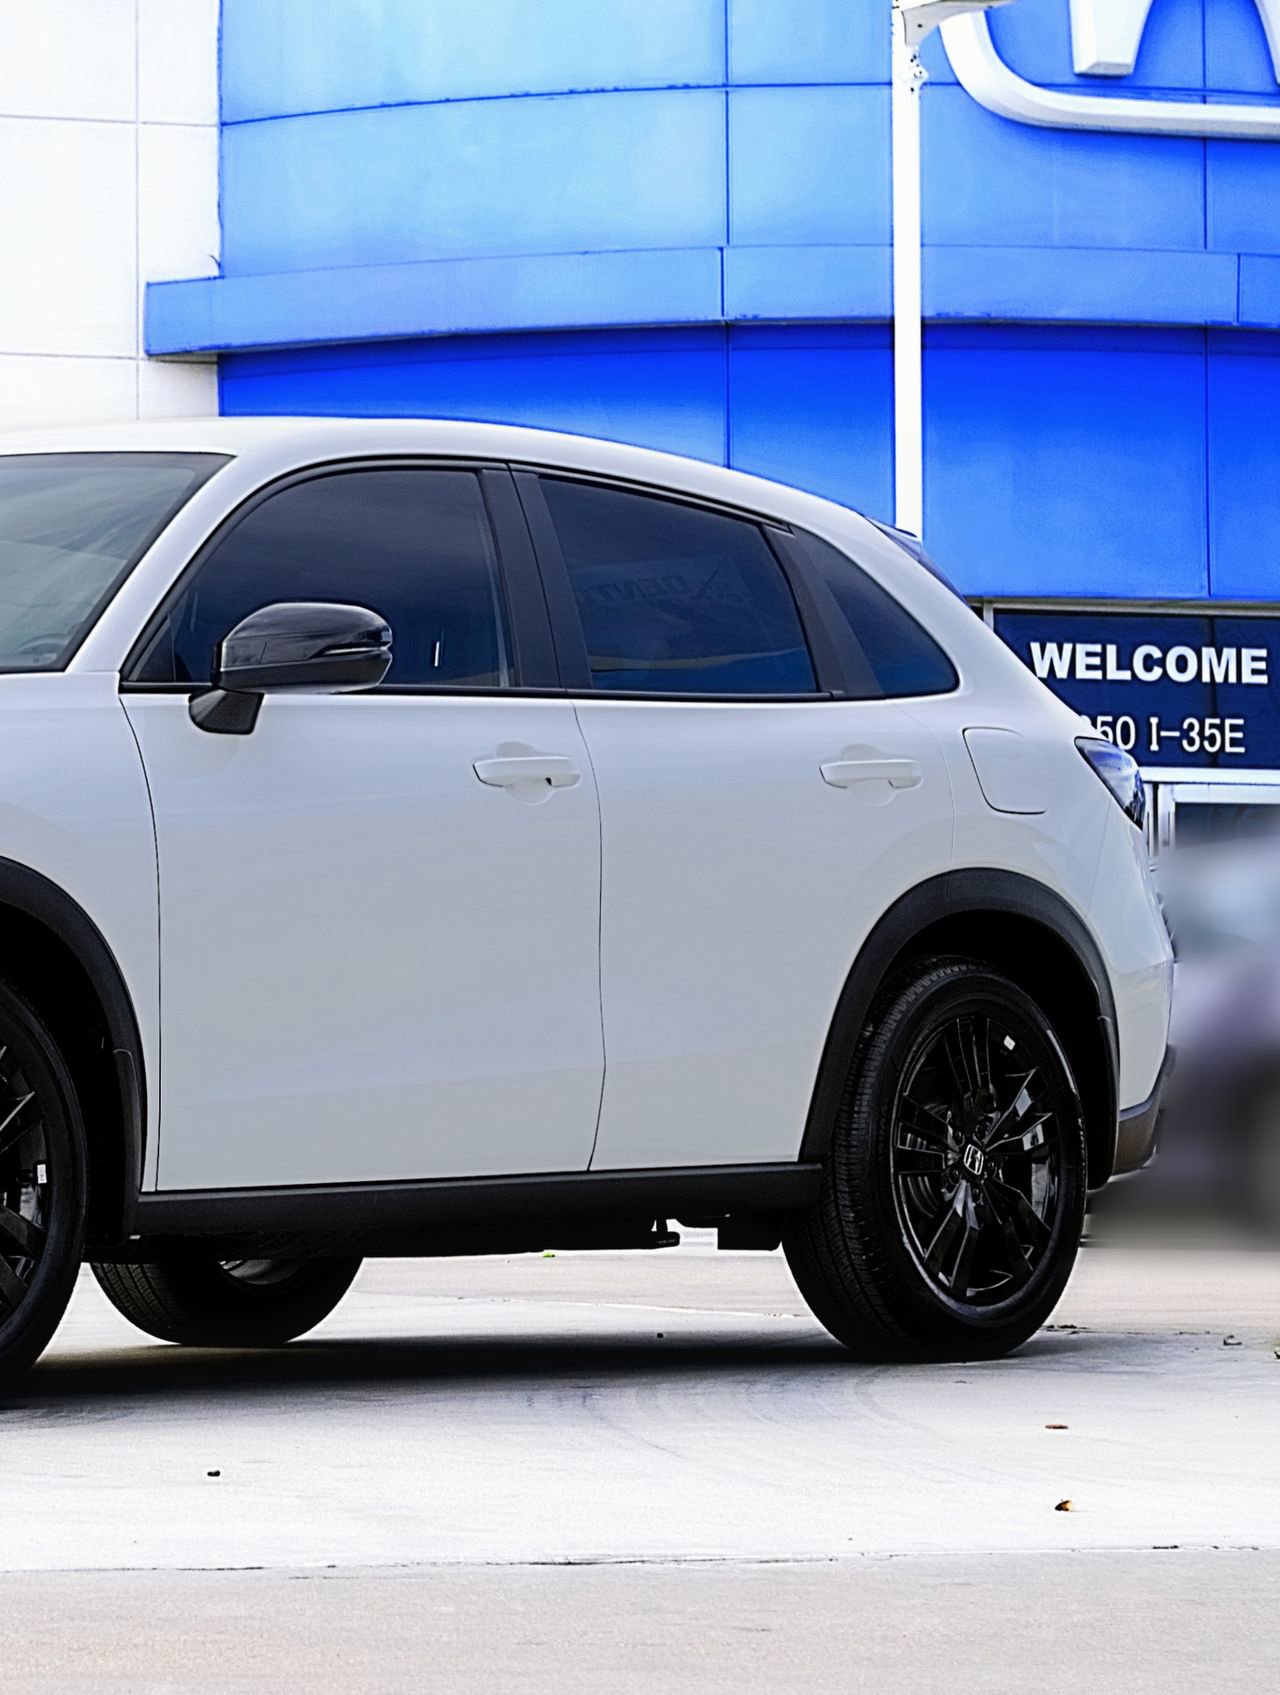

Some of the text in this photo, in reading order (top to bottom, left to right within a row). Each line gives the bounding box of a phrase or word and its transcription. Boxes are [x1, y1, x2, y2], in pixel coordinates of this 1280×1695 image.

[1030, 641, 1269, 684] WELCOME
[1080, 714, 1246, 753] 50 I-35E
